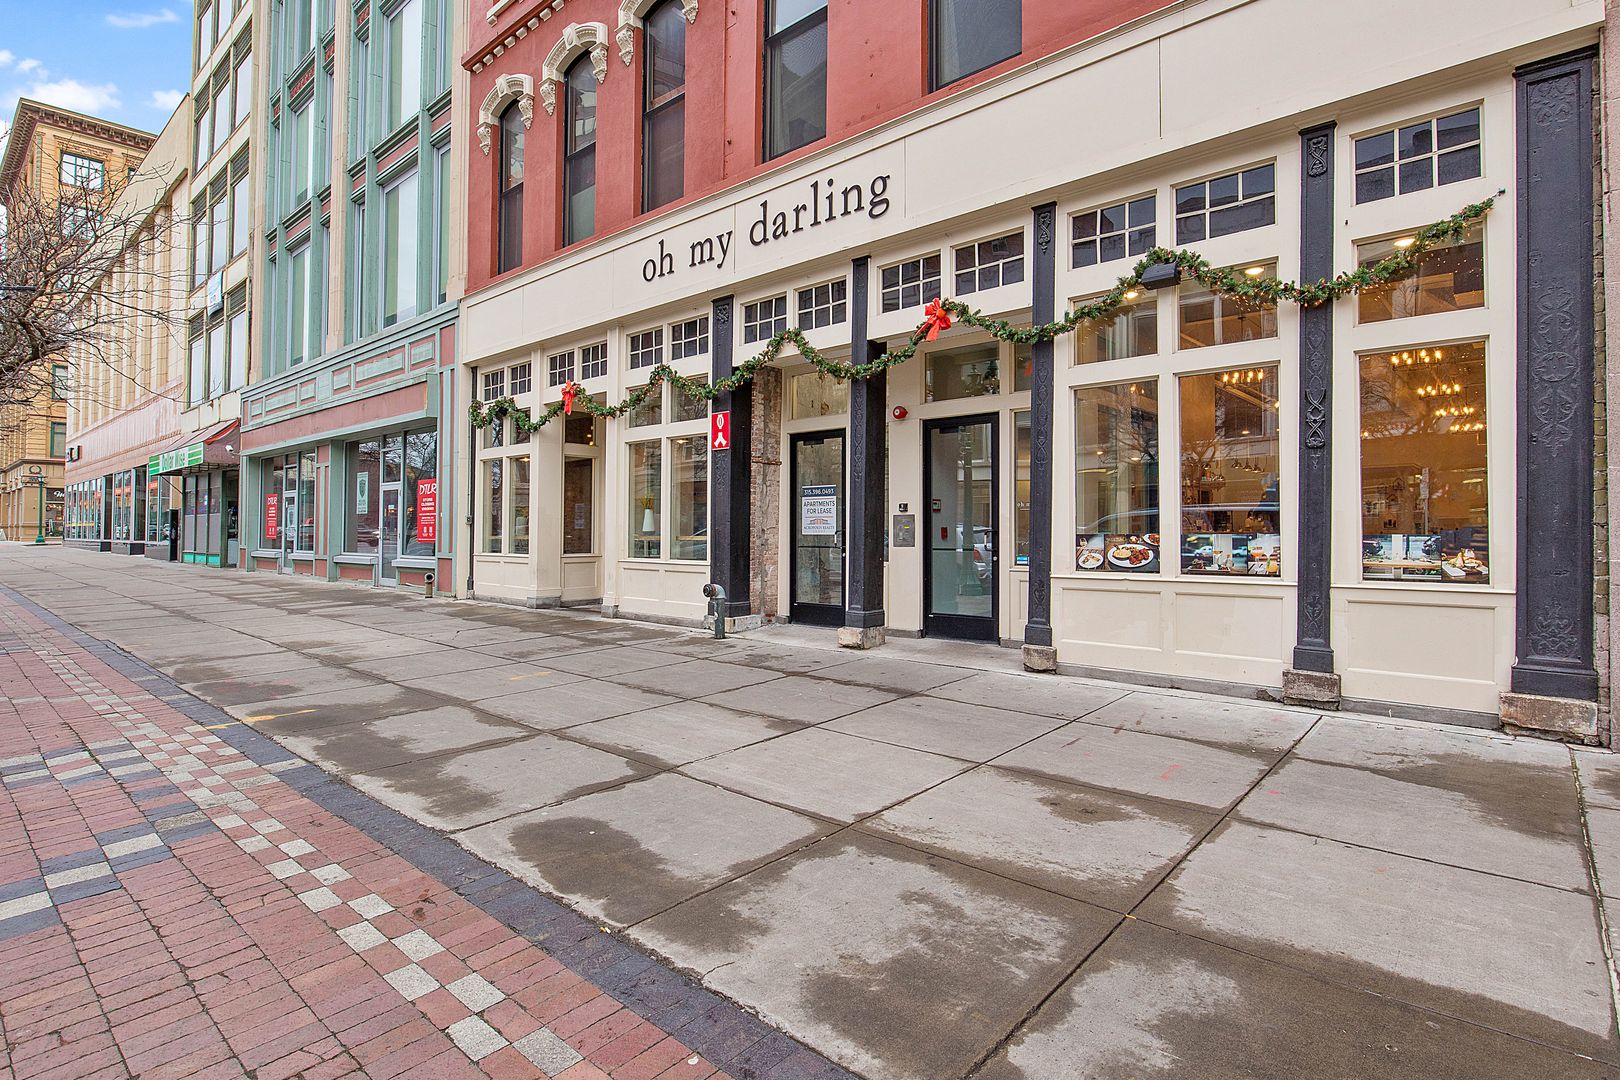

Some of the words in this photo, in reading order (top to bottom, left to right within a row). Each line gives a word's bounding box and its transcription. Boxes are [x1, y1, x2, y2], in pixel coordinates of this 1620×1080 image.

[642, 239, 675, 282] oh
[689, 229, 734, 269] my
[749, 174, 890, 247] darling
[420, 482, 436, 495] DTLR
